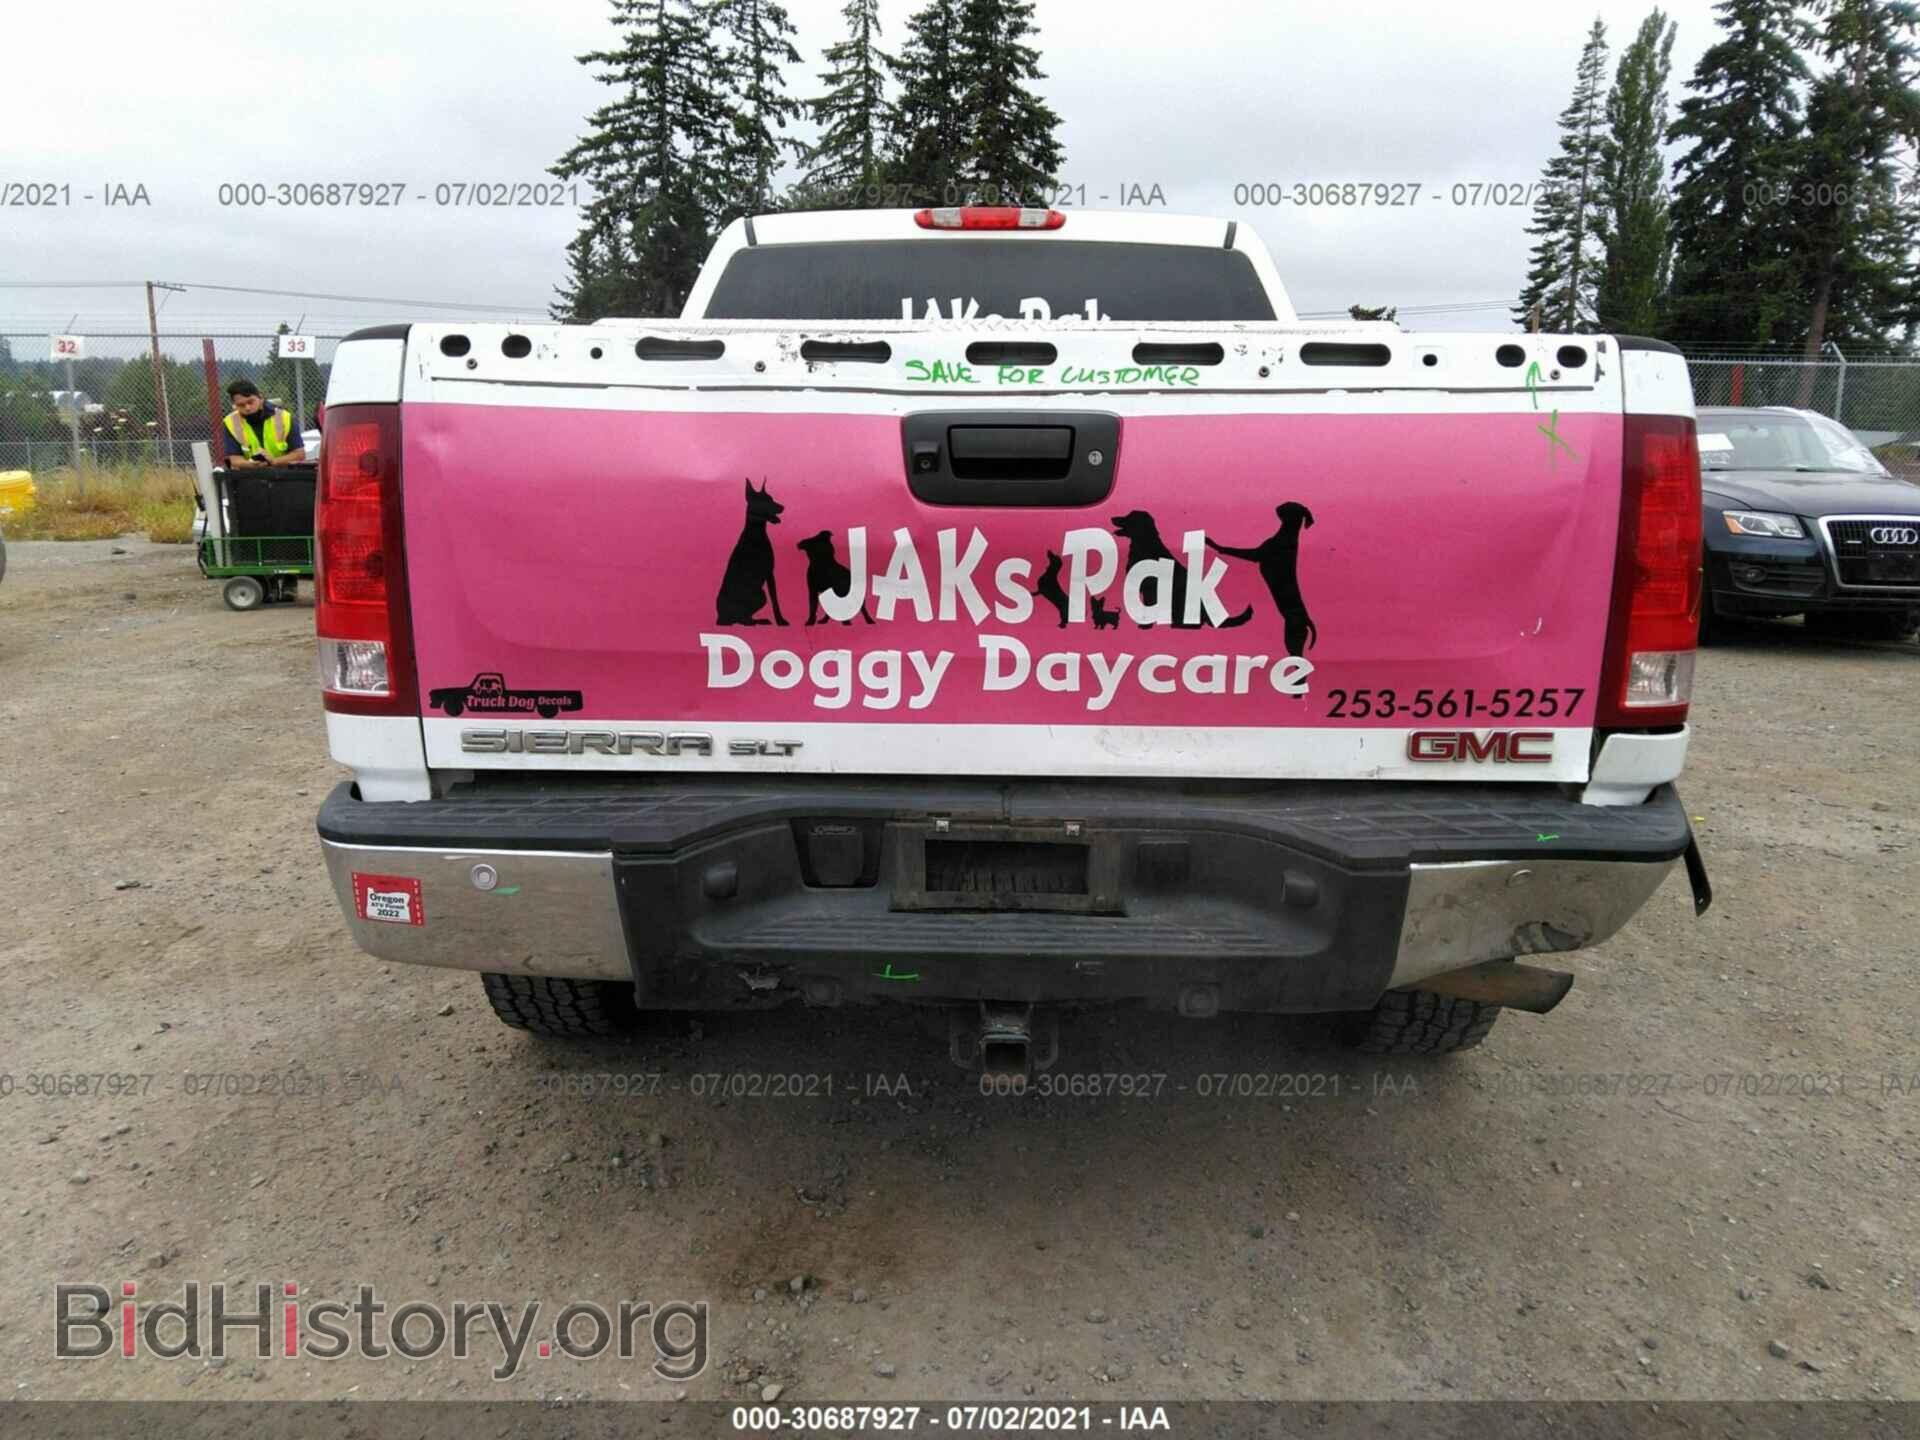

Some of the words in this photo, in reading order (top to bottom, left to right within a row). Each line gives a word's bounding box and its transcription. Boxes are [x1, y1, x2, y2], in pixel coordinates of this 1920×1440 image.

[57, 339, 77, 353] 32
[287, 338, 306, 353] 33
[997, 364, 1044, 385] FOR
[1060, 364, 1201, 386] CUSTOMER
[818, 526, 1034, 626] JAKs
[1062, 527, 1231, 628] Pak
[699, 632, 955, 710] Doggy
[978, 634, 1315, 711] Daycare
[466, 695, 505, 707] Truck
[508, 696, 536, 710] Dog
[538, 696, 572, 706] Decals
[1326, 688, 1586, 719] 253-561-5257
[461, 728, 713, 756] SIERRA
[727, 739, 803, 757] SLT
[1407, 729, 1555, 763] GMC
[369, 892, 405, 904] Oregon
[377, 909, 400, 918] 2022
